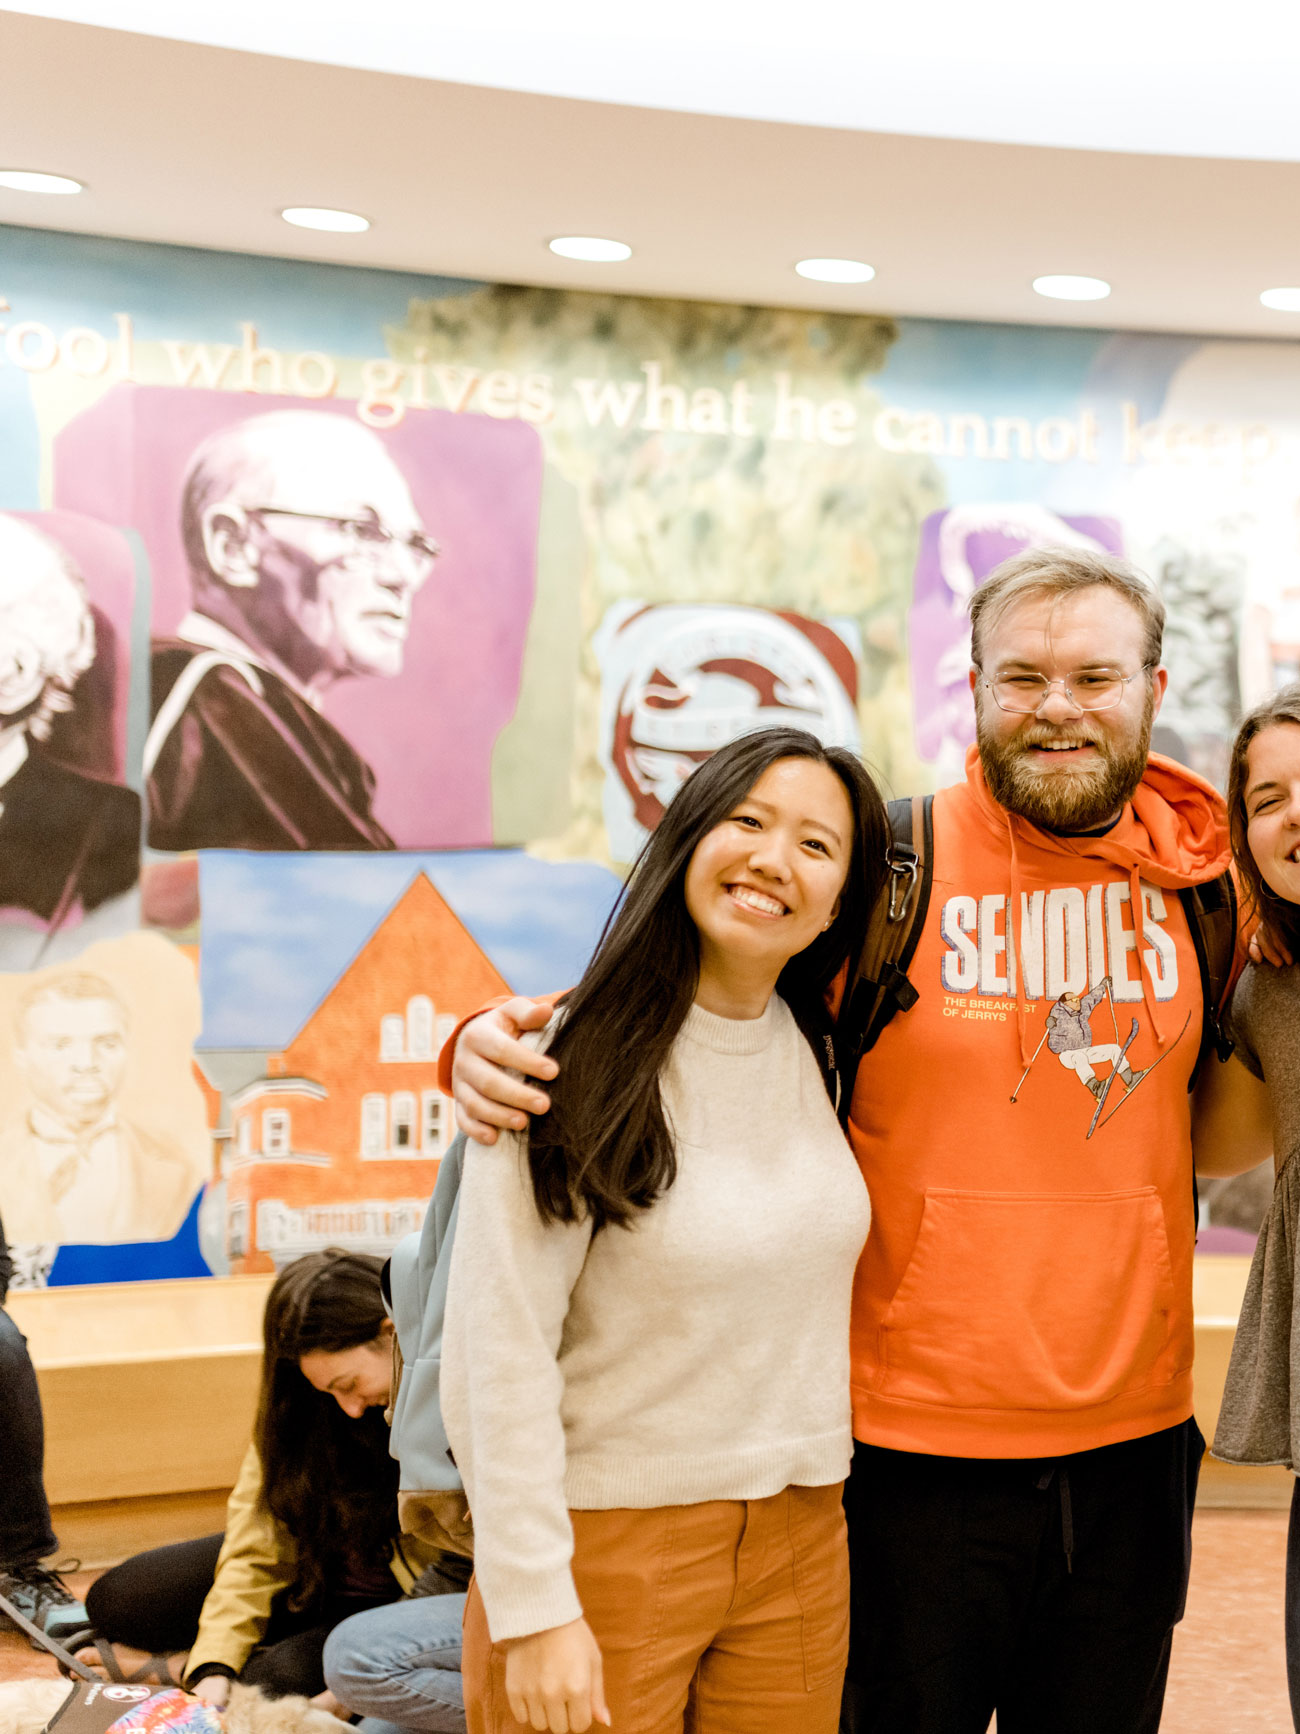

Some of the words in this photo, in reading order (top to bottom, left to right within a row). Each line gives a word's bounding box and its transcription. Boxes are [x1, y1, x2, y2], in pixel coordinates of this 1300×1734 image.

[0, 296, 136, 384] ool
[162, 320, 340, 398] who
[357, 346, 554, 429] gives
[571, 360, 757, 438] what
[769, 373, 858, 447] he
[873, 405, 1098, 464] cannot
[940, 881, 1179, 1004] SENDIES
[942, 1007, 960, 1017] OF
[961, 1009, 1007, 1022] JERRYS
[944, 996, 967, 1008] THE
[969, 999, 1037, 1014] BREAKFST
